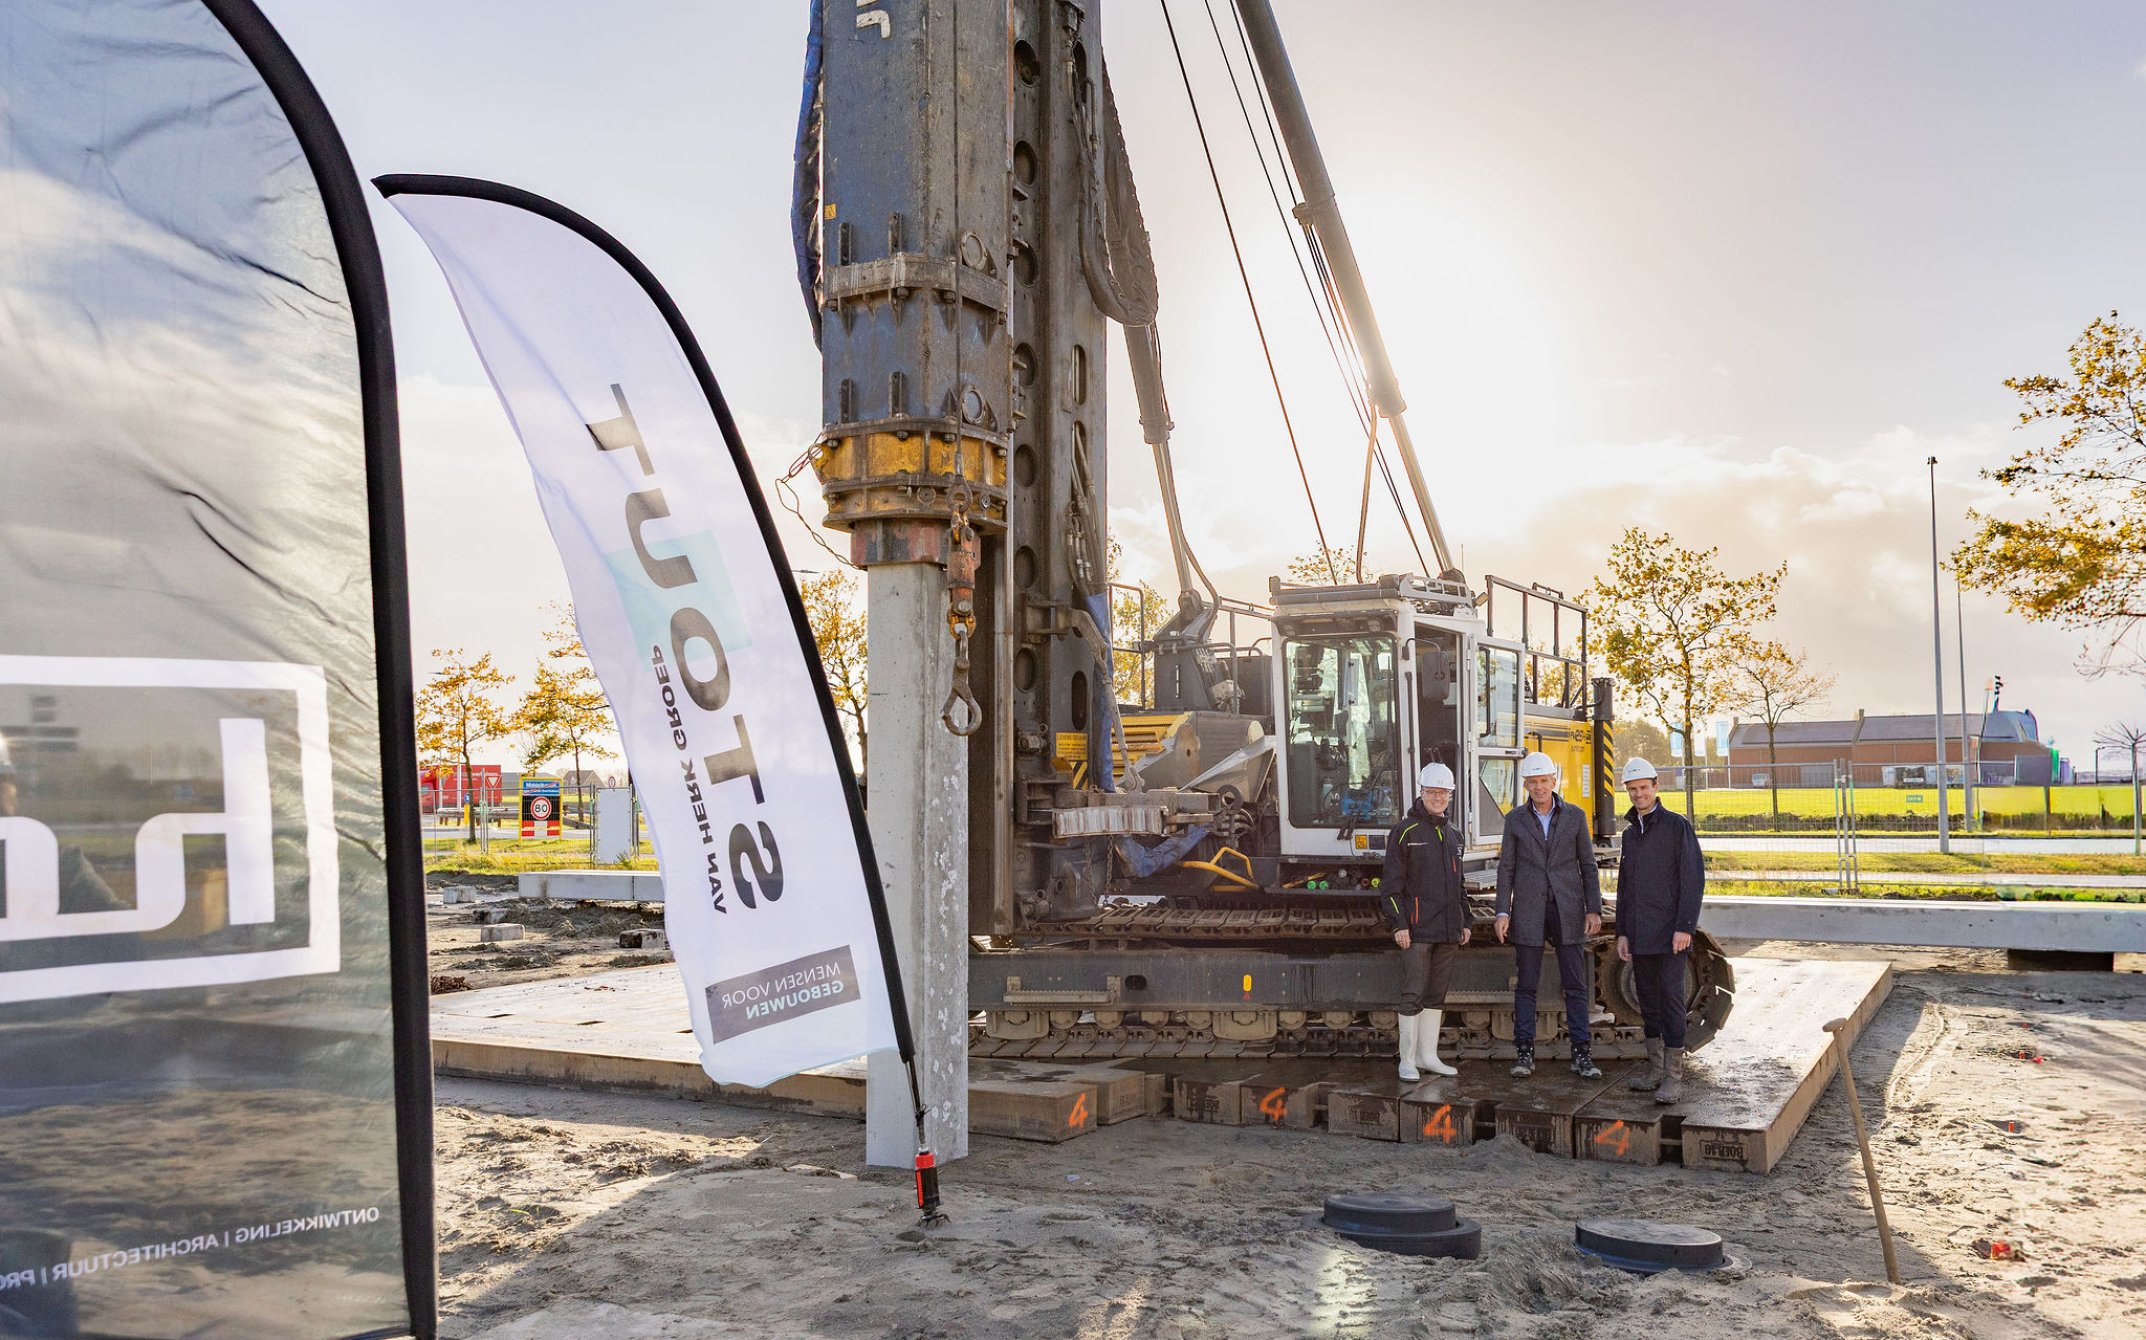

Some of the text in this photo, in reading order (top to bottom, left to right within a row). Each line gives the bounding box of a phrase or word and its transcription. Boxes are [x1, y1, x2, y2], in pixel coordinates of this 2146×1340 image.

[535, 804, 548, 813] 80
[1068, 1093, 1088, 1128] 4
[1259, 1087, 1288, 1120] 4
[1423, 1104, 1457, 1144] 4
[1594, 1120, 1631, 1156] 4
